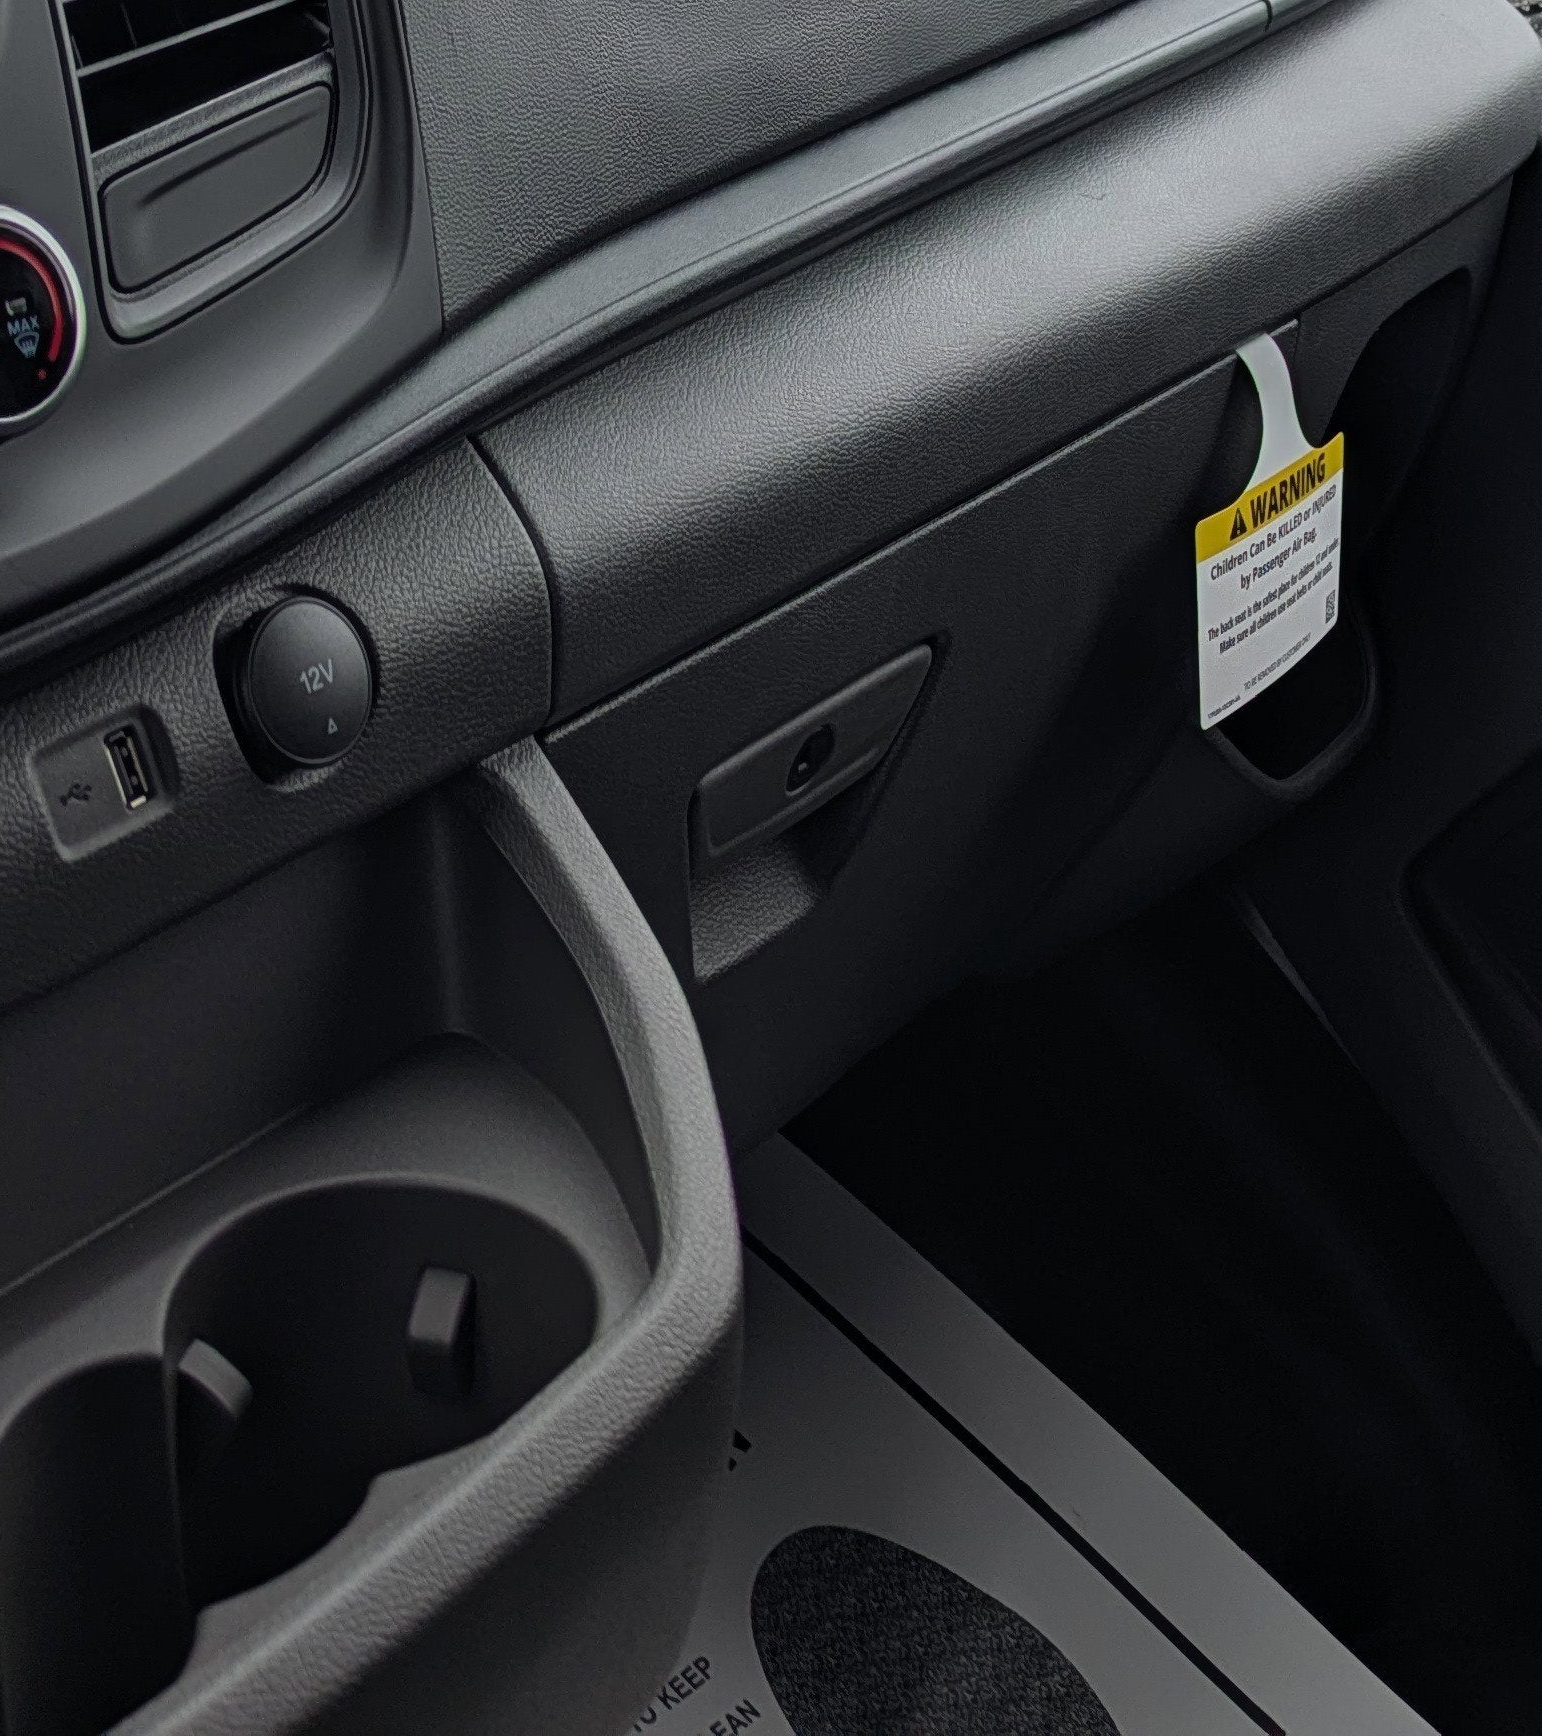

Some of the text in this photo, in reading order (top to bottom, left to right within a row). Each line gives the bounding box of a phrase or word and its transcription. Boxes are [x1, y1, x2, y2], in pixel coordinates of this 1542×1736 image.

[6, 314, 41, 337] MAX
[1249, 451, 1326, 529] WARNING
[1210, 550, 1248, 581] Children
[1249, 540, 1265, 559] Can
[1266, 531, 1277, 548] Be
[1278, 511, 1303, 541] KILLED
[1303, 505, 1312, 522] or
[1240, 573, 1251, 591] by
[1252, 546, 1292, 583] Passenger
[1291, 537, 1302, 556] Air
[1208, 626, 1220, 642] The
[1220, 616, 1234, 635] back
[299, 657, 335, 695] 12V
[656, 1655, 711, 1711] KEEP
